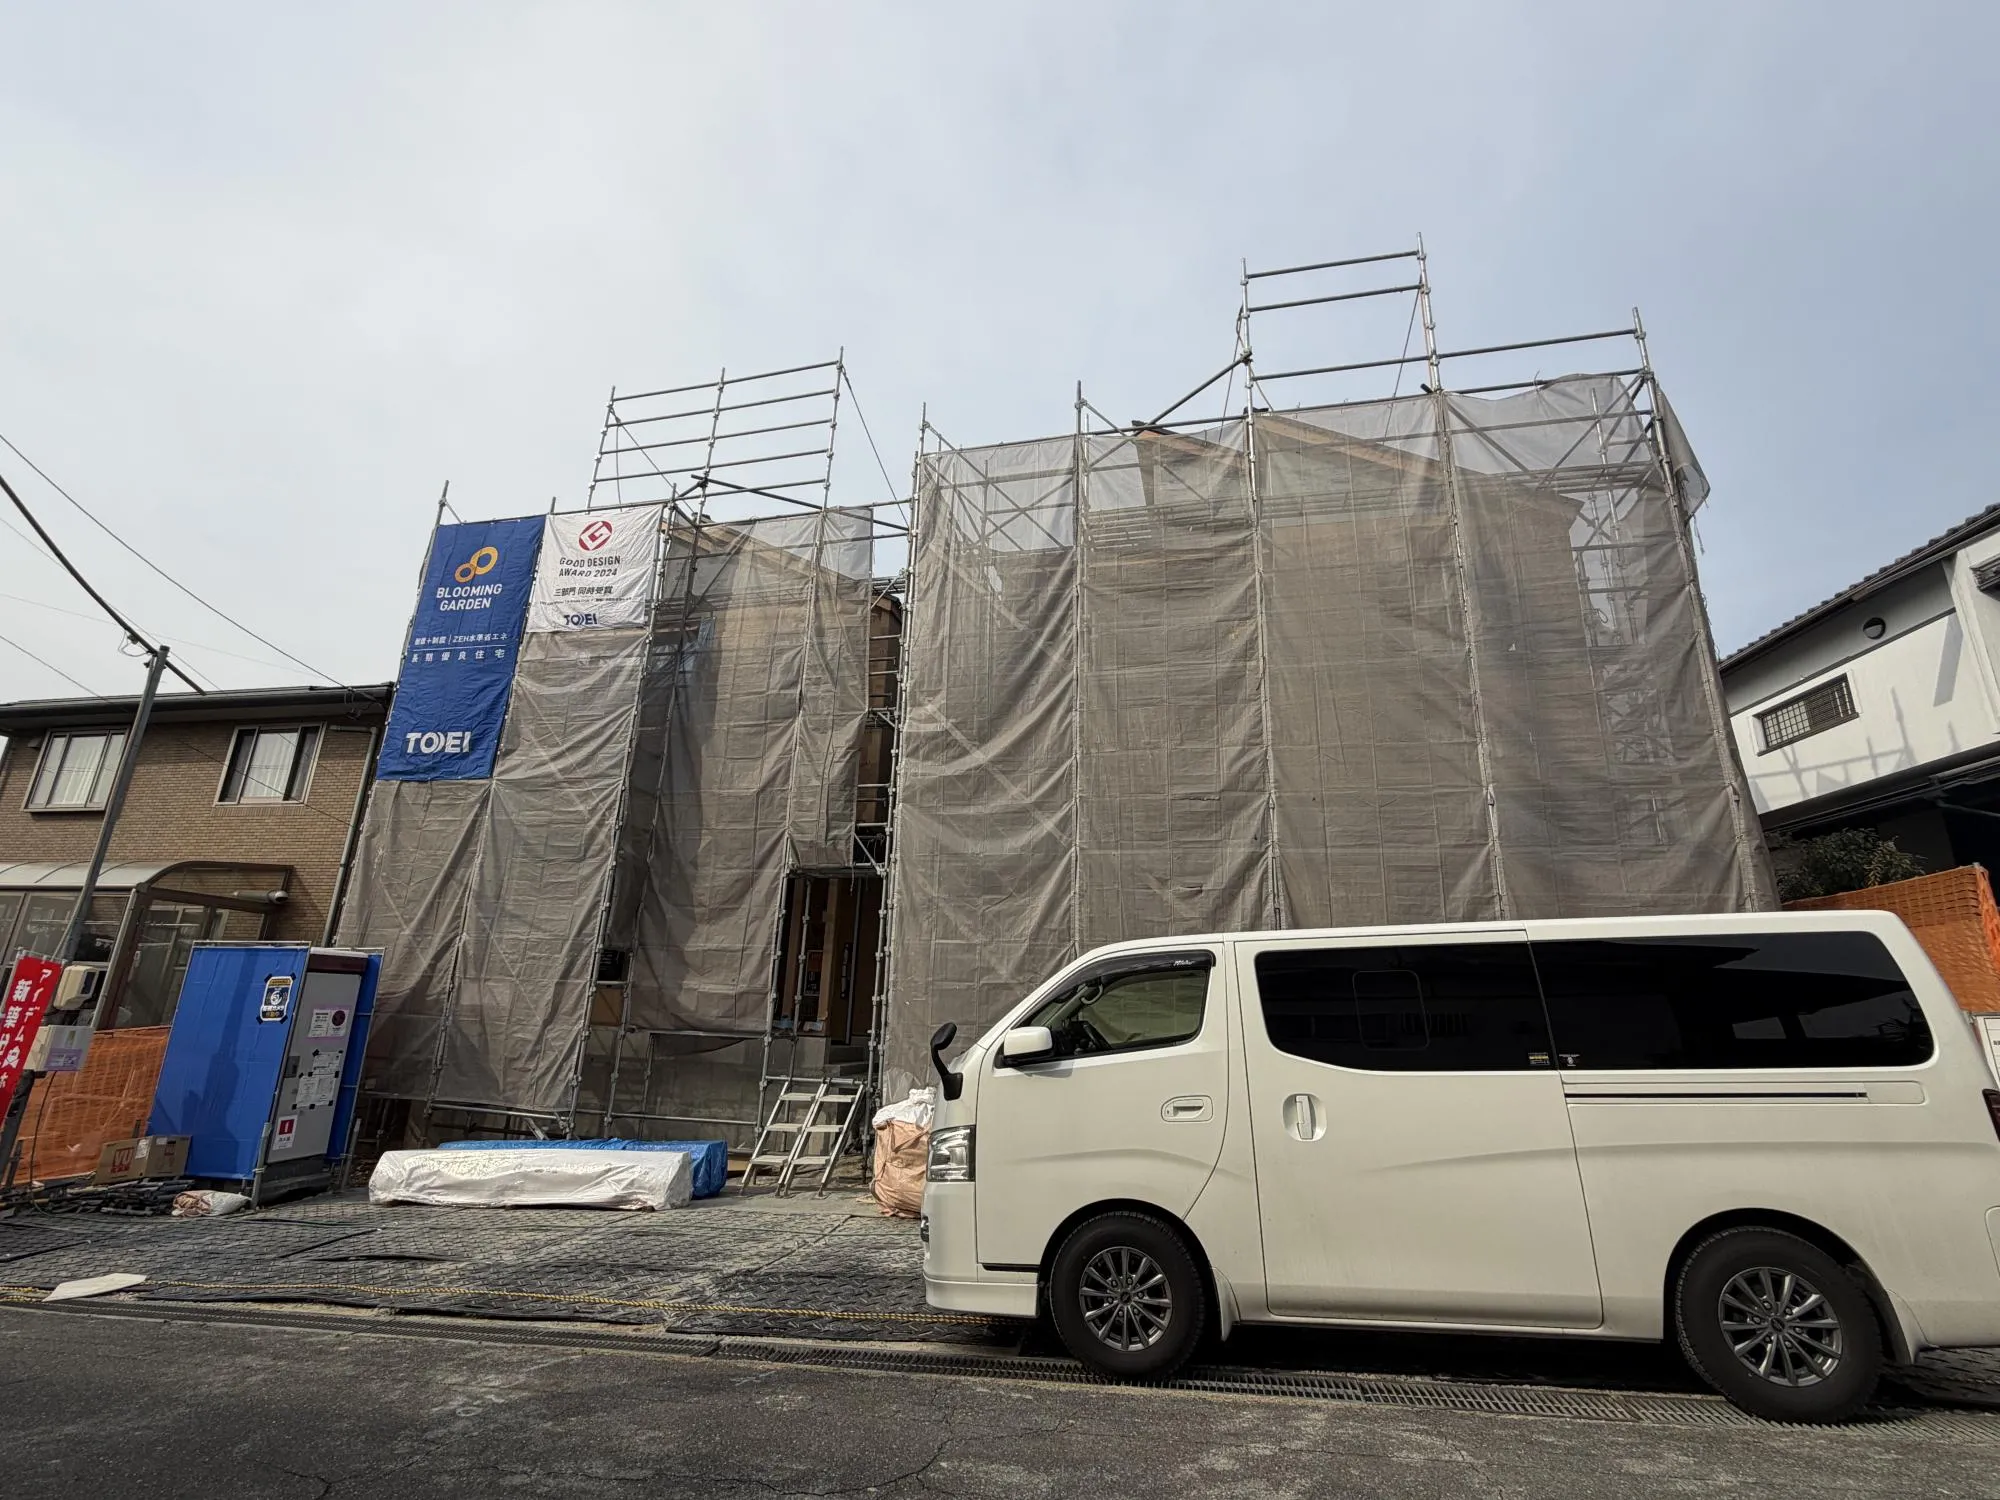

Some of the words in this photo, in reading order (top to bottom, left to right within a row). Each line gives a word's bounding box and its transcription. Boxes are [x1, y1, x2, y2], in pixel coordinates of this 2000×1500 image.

[560, 557, 585, 567] GOOD
[587, 555, 621, 567] DESIGN
[559, 568, 592, 577] AWARD
[593, 568, 618, 577] 2024
[436, 583, 503, 598] BLOOMING
[440, 597, 491, 611] GARDEN
